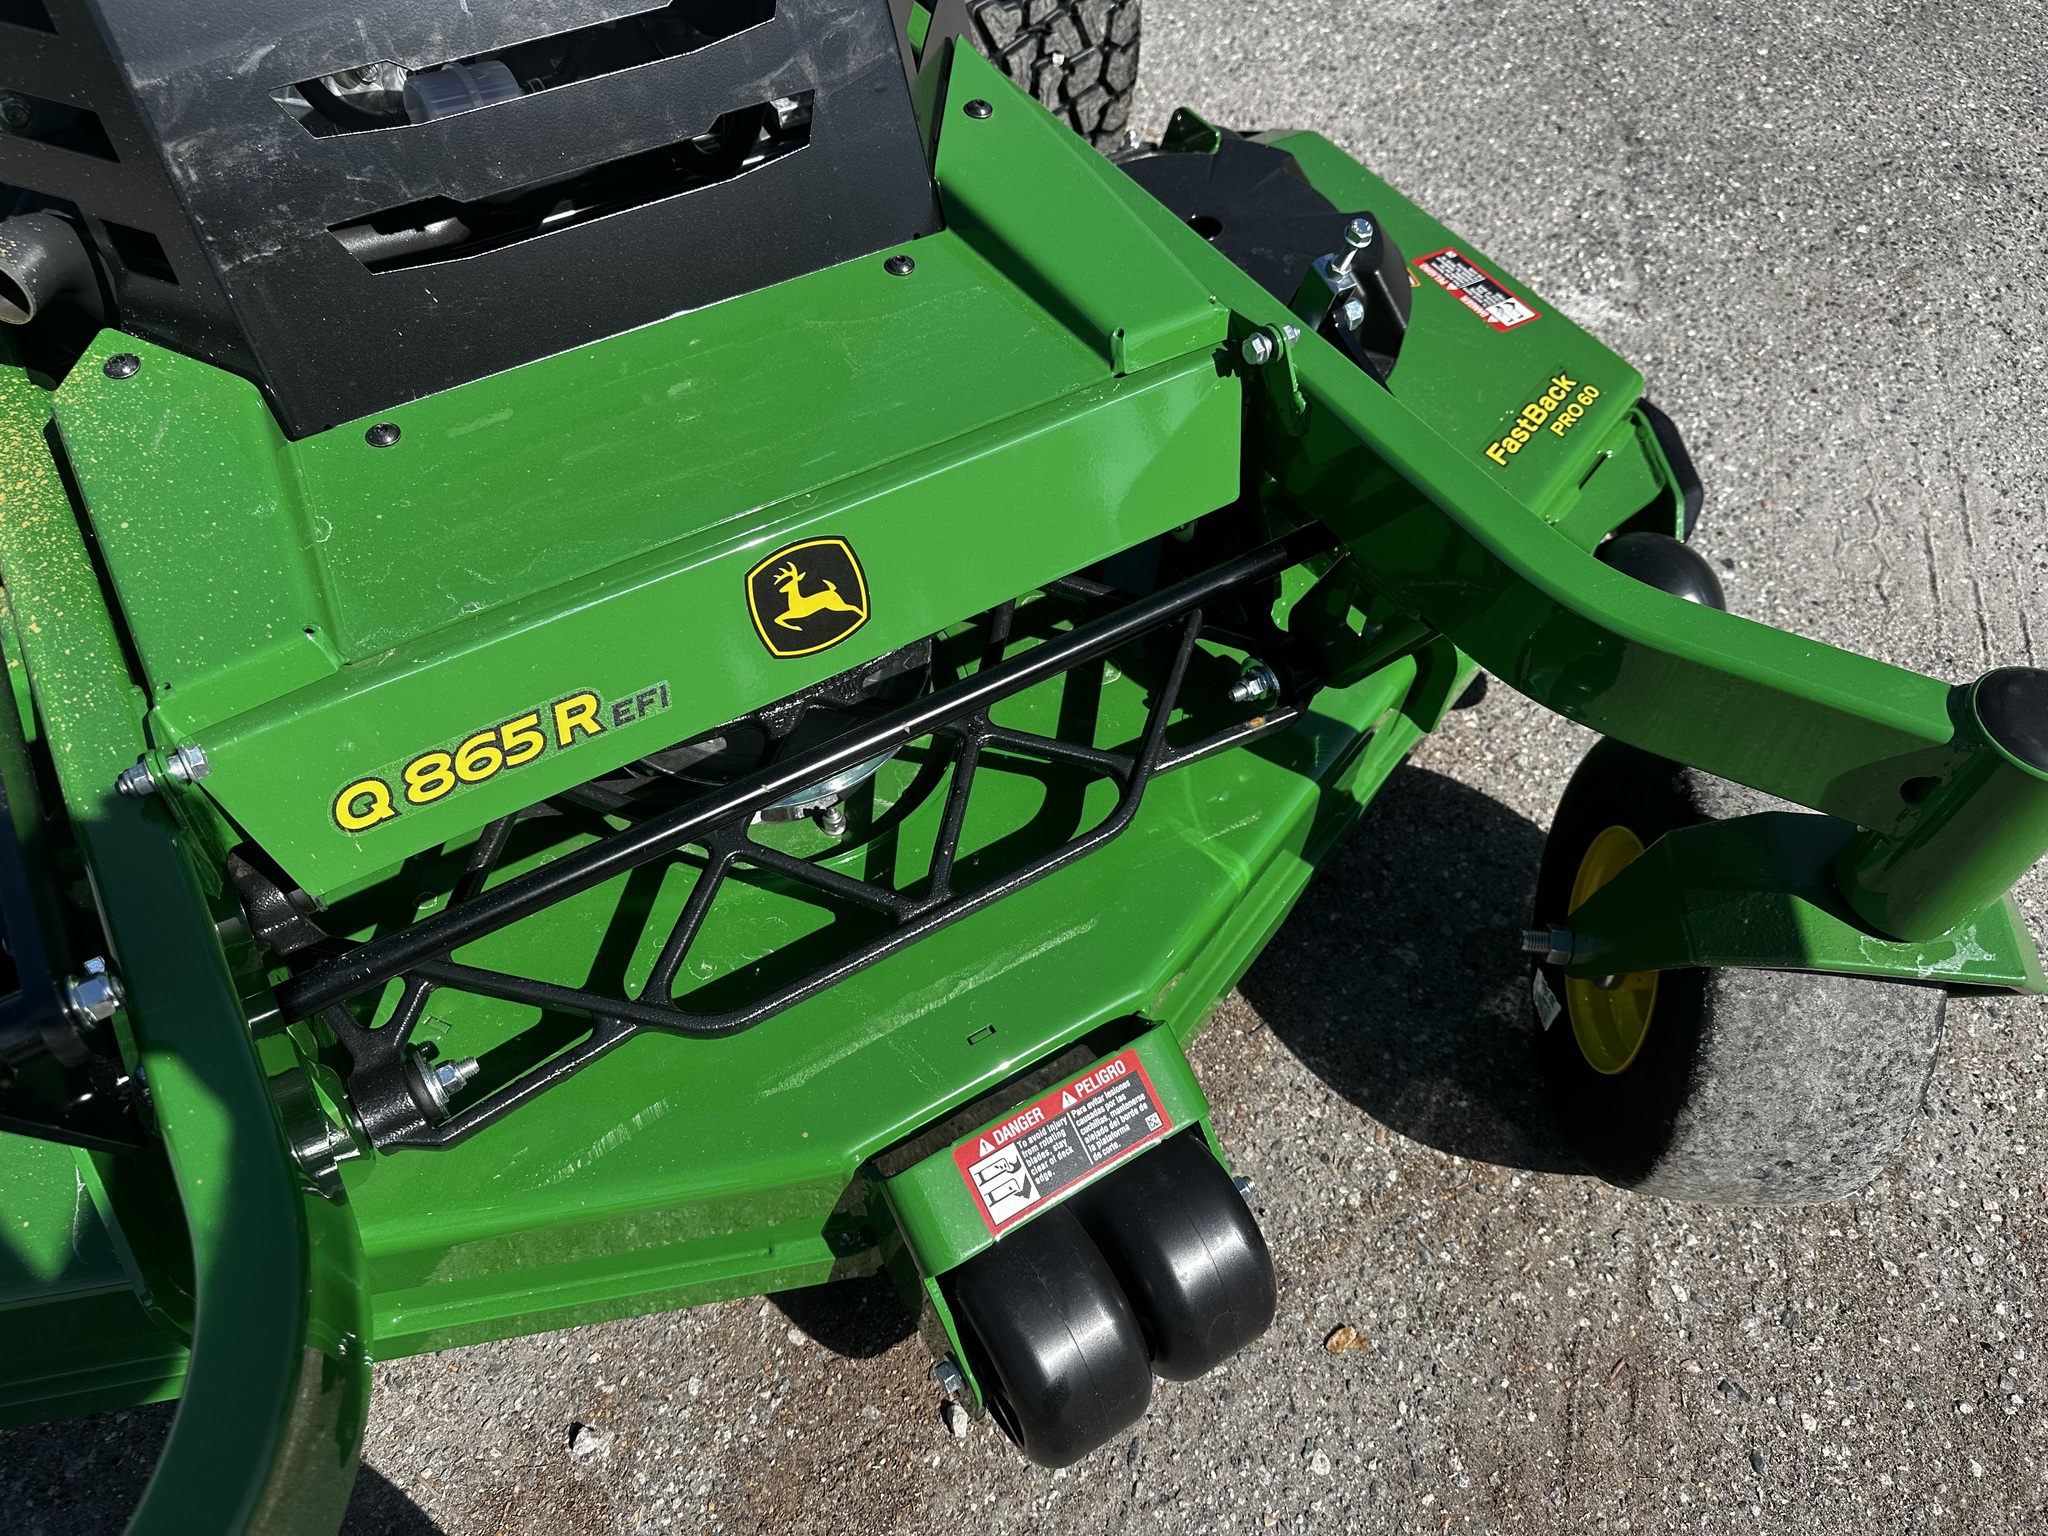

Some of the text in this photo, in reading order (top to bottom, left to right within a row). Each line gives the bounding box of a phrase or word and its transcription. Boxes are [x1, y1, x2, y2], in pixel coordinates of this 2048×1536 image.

[1419, 262, 1449, 286] PELIGRO
[1460, 294, 1490, 318] DANGER
[1484, 373, 1578, 466] FastBack
[1549, 385, 1600, 437] PRO 60
[332, 776, 402, 834] Q
[611, 684, 669, 728] EFI
[1074, 1059, 1126, 1098] PELIGRO
[1070, 1080, 1131, 1119] Para evitar lesiones
[1075, 1093, 1127, 1127] causadas por las
[1080, 1093, 1146, 1136] cuchillas, mantenerse
[992, 1106, 1045, 1146] DANGER
[1016, 1117, 1068, 1149] To avoid injury
[1084, 1102, 1148, 1144] alejado del borde de
[1087, 1143, 1097, 1153] la
[1096, 1124, 1131, 1150] plataforma
[1021, 1129, 1067, 1159] from rotating
[1026, 1138, 1068, 1167] blades, stay
[1030, 1145, 1075, 1176] clear of deck
[1093, 1141, 1121, 1161] de corte.
[1034, 1170, 1056, 1185] edge.
